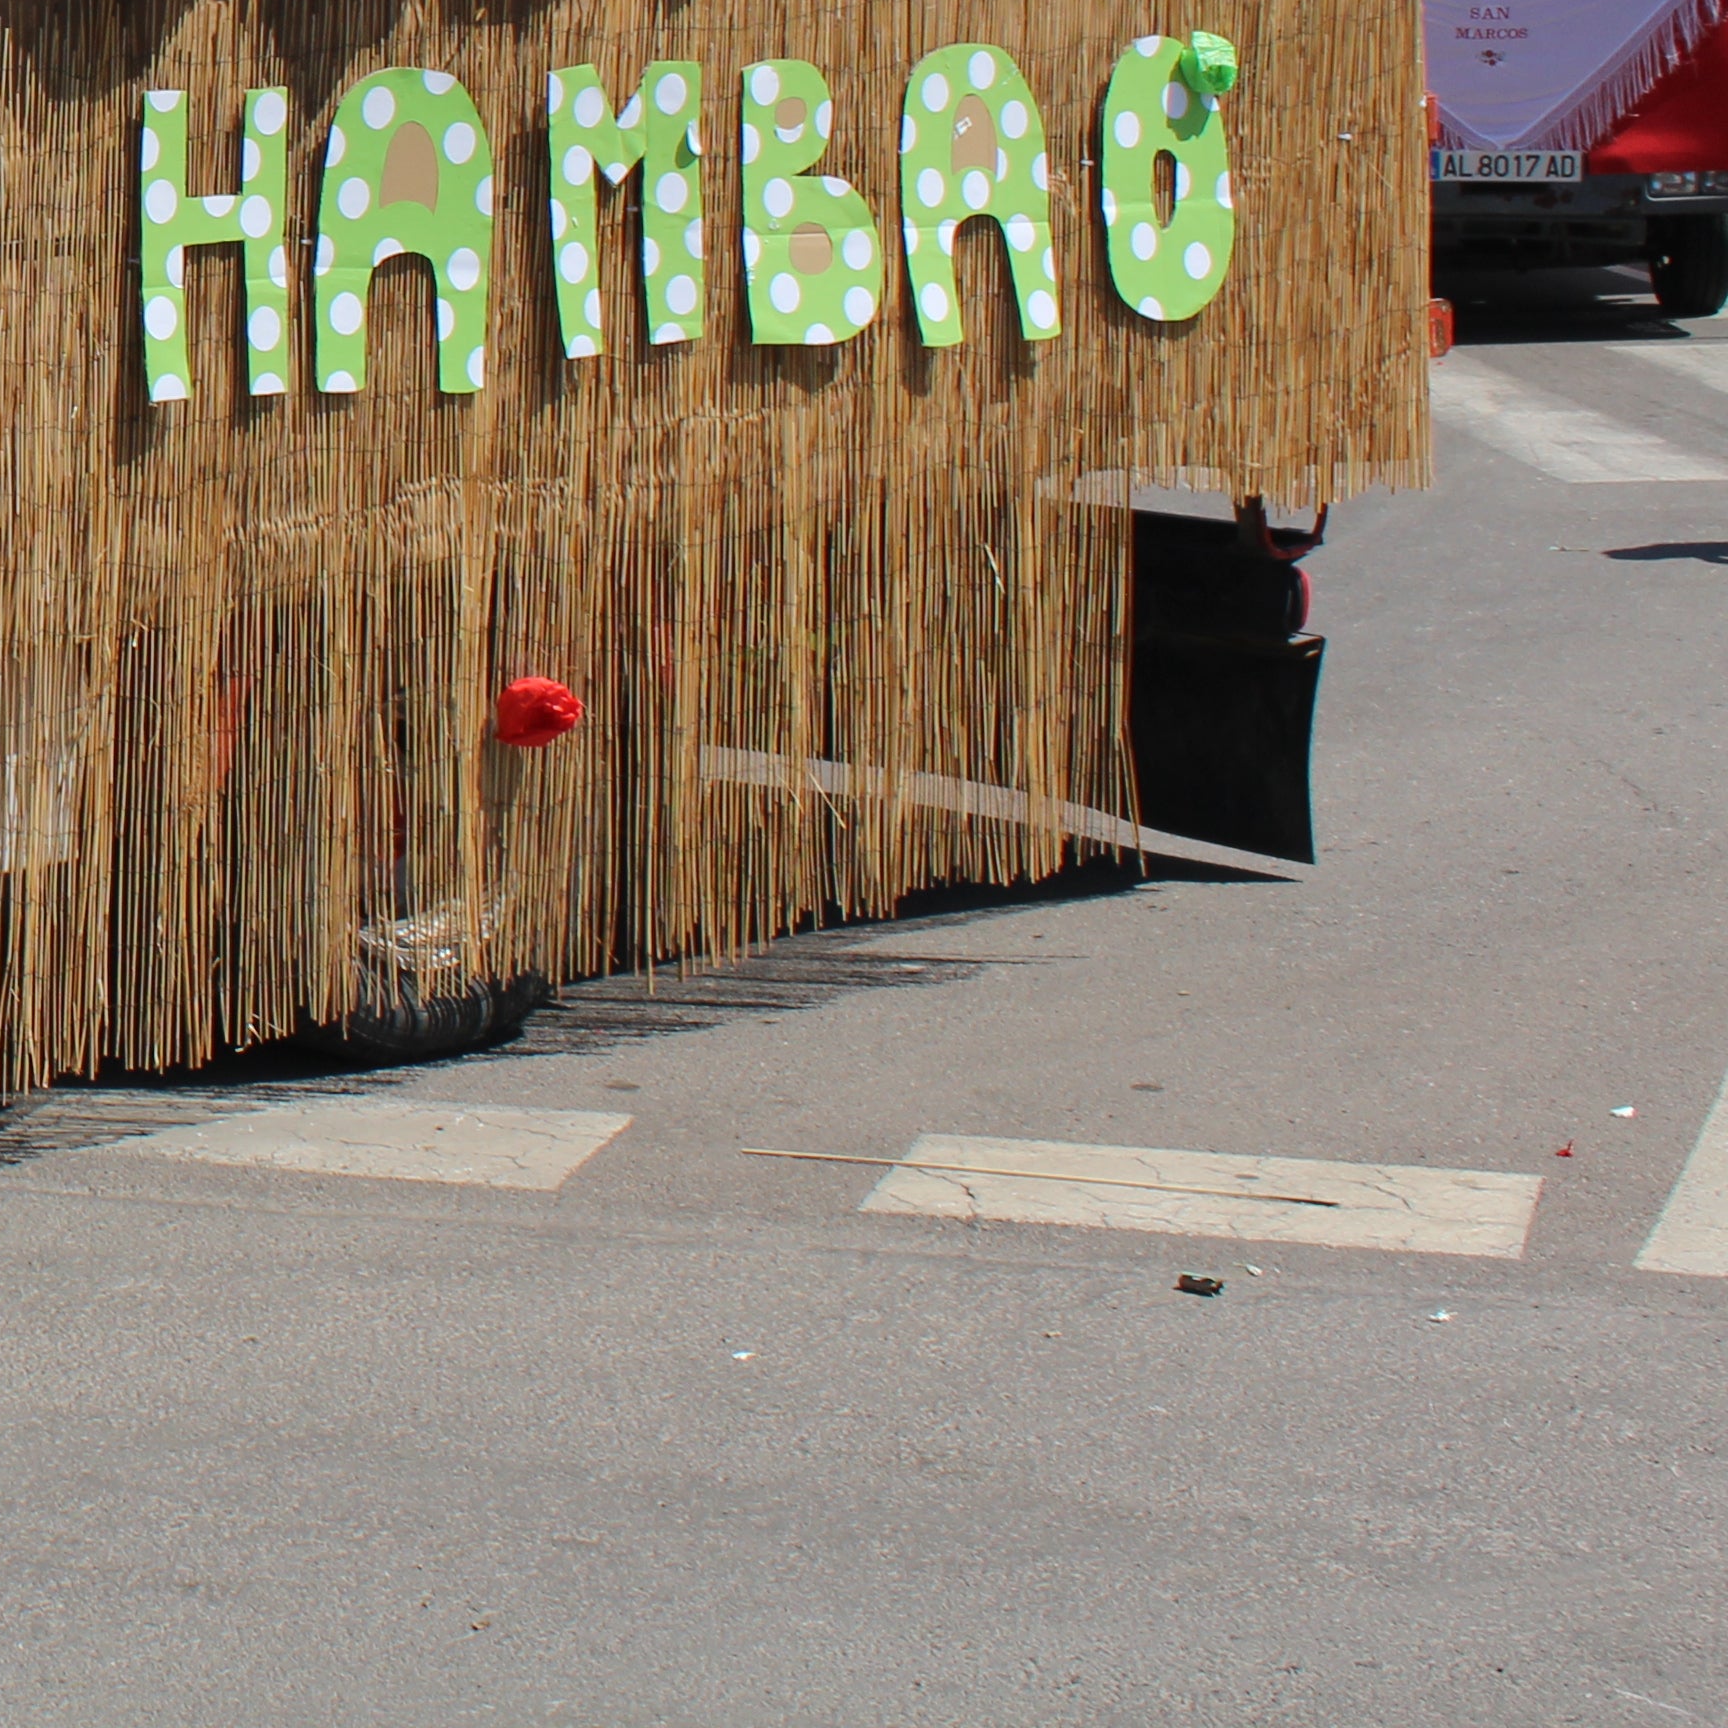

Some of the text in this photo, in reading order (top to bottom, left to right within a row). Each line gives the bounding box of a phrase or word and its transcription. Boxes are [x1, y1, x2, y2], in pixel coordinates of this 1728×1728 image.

[1469, 6, 1511, 20] SAN
[1455, 27, 1529, 40] MARCOS
[1443, 154, 1576, 178] AL 8017 AD
